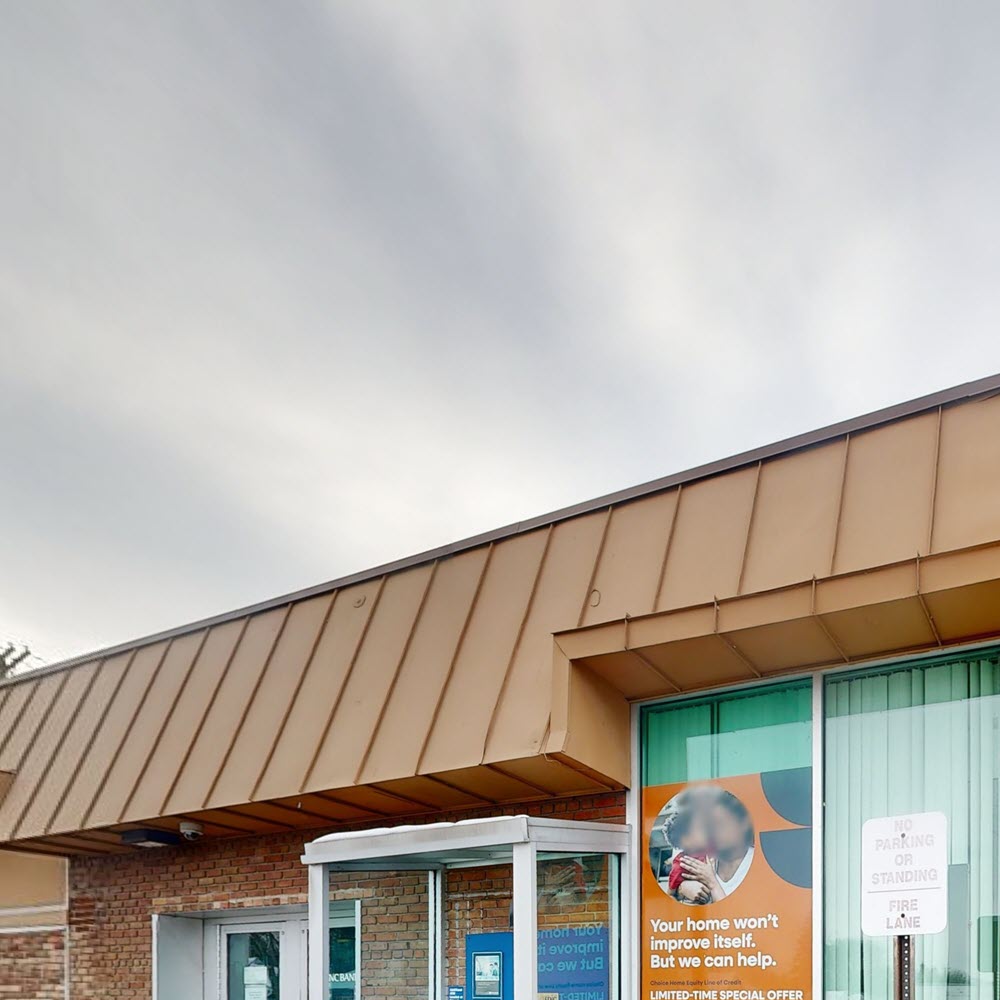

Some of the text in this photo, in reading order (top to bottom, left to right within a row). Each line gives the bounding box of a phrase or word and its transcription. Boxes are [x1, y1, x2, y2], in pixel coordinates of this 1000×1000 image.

[894, 819, 912, 832] NO
[875, 834, 934, 851] PARKING
[894, 854, 913, 866] OR
[872, 868, 938, 885] STANDING
[889, 899, 918, 912] FIRE
[650, 914, 779, 932] Your home won’t
[886, 916, 920, 929] LANE
[650, 933, 756, 953] improve itself.
[650, 952, 777, 969] But we can help.
[328, 973, 339, 982] NC
[650, 990, 803, 1000] LIMITED-TIME SPECIAL OFFER
